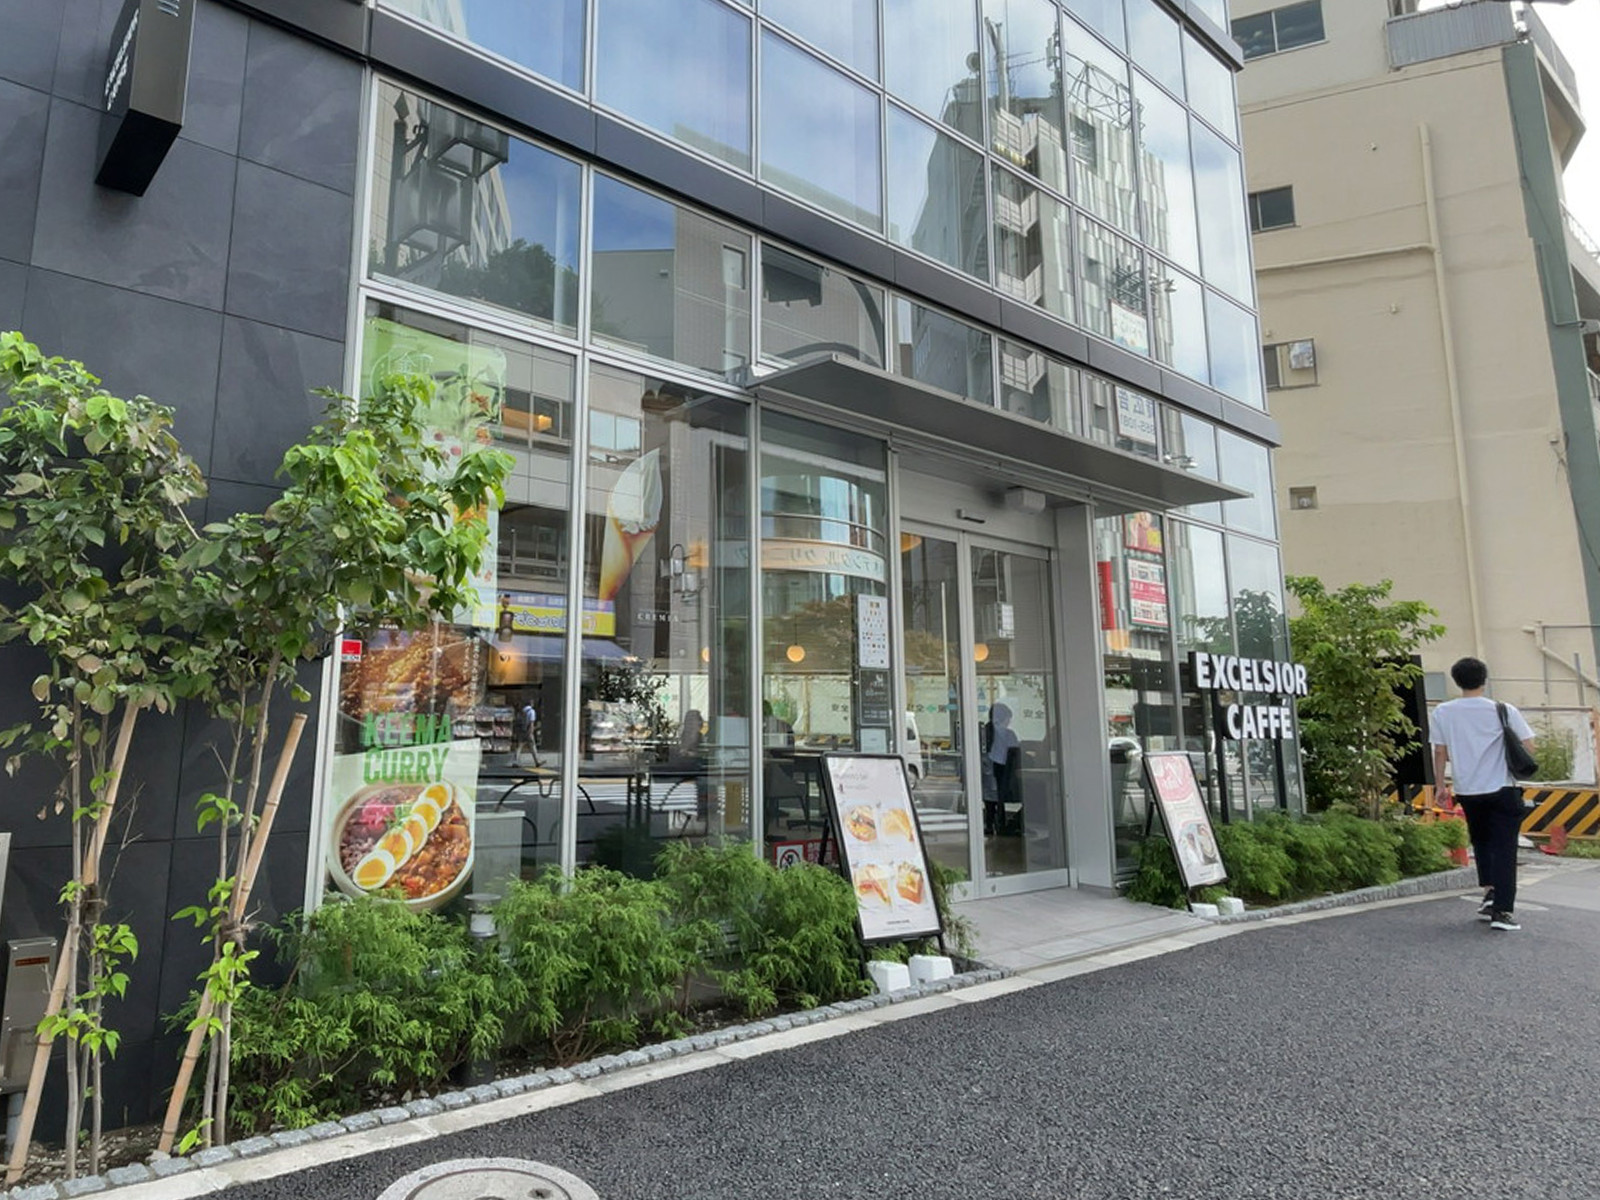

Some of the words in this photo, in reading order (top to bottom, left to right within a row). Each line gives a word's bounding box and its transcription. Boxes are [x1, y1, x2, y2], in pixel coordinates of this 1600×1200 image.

[1195, 652, 1308, 696] EXCELSIOR
[363, 713, 451, 746] KEEMA
[1227, 698, 1293, 740] CAFFÉ
[363, 747, 449, 784] CURRY
